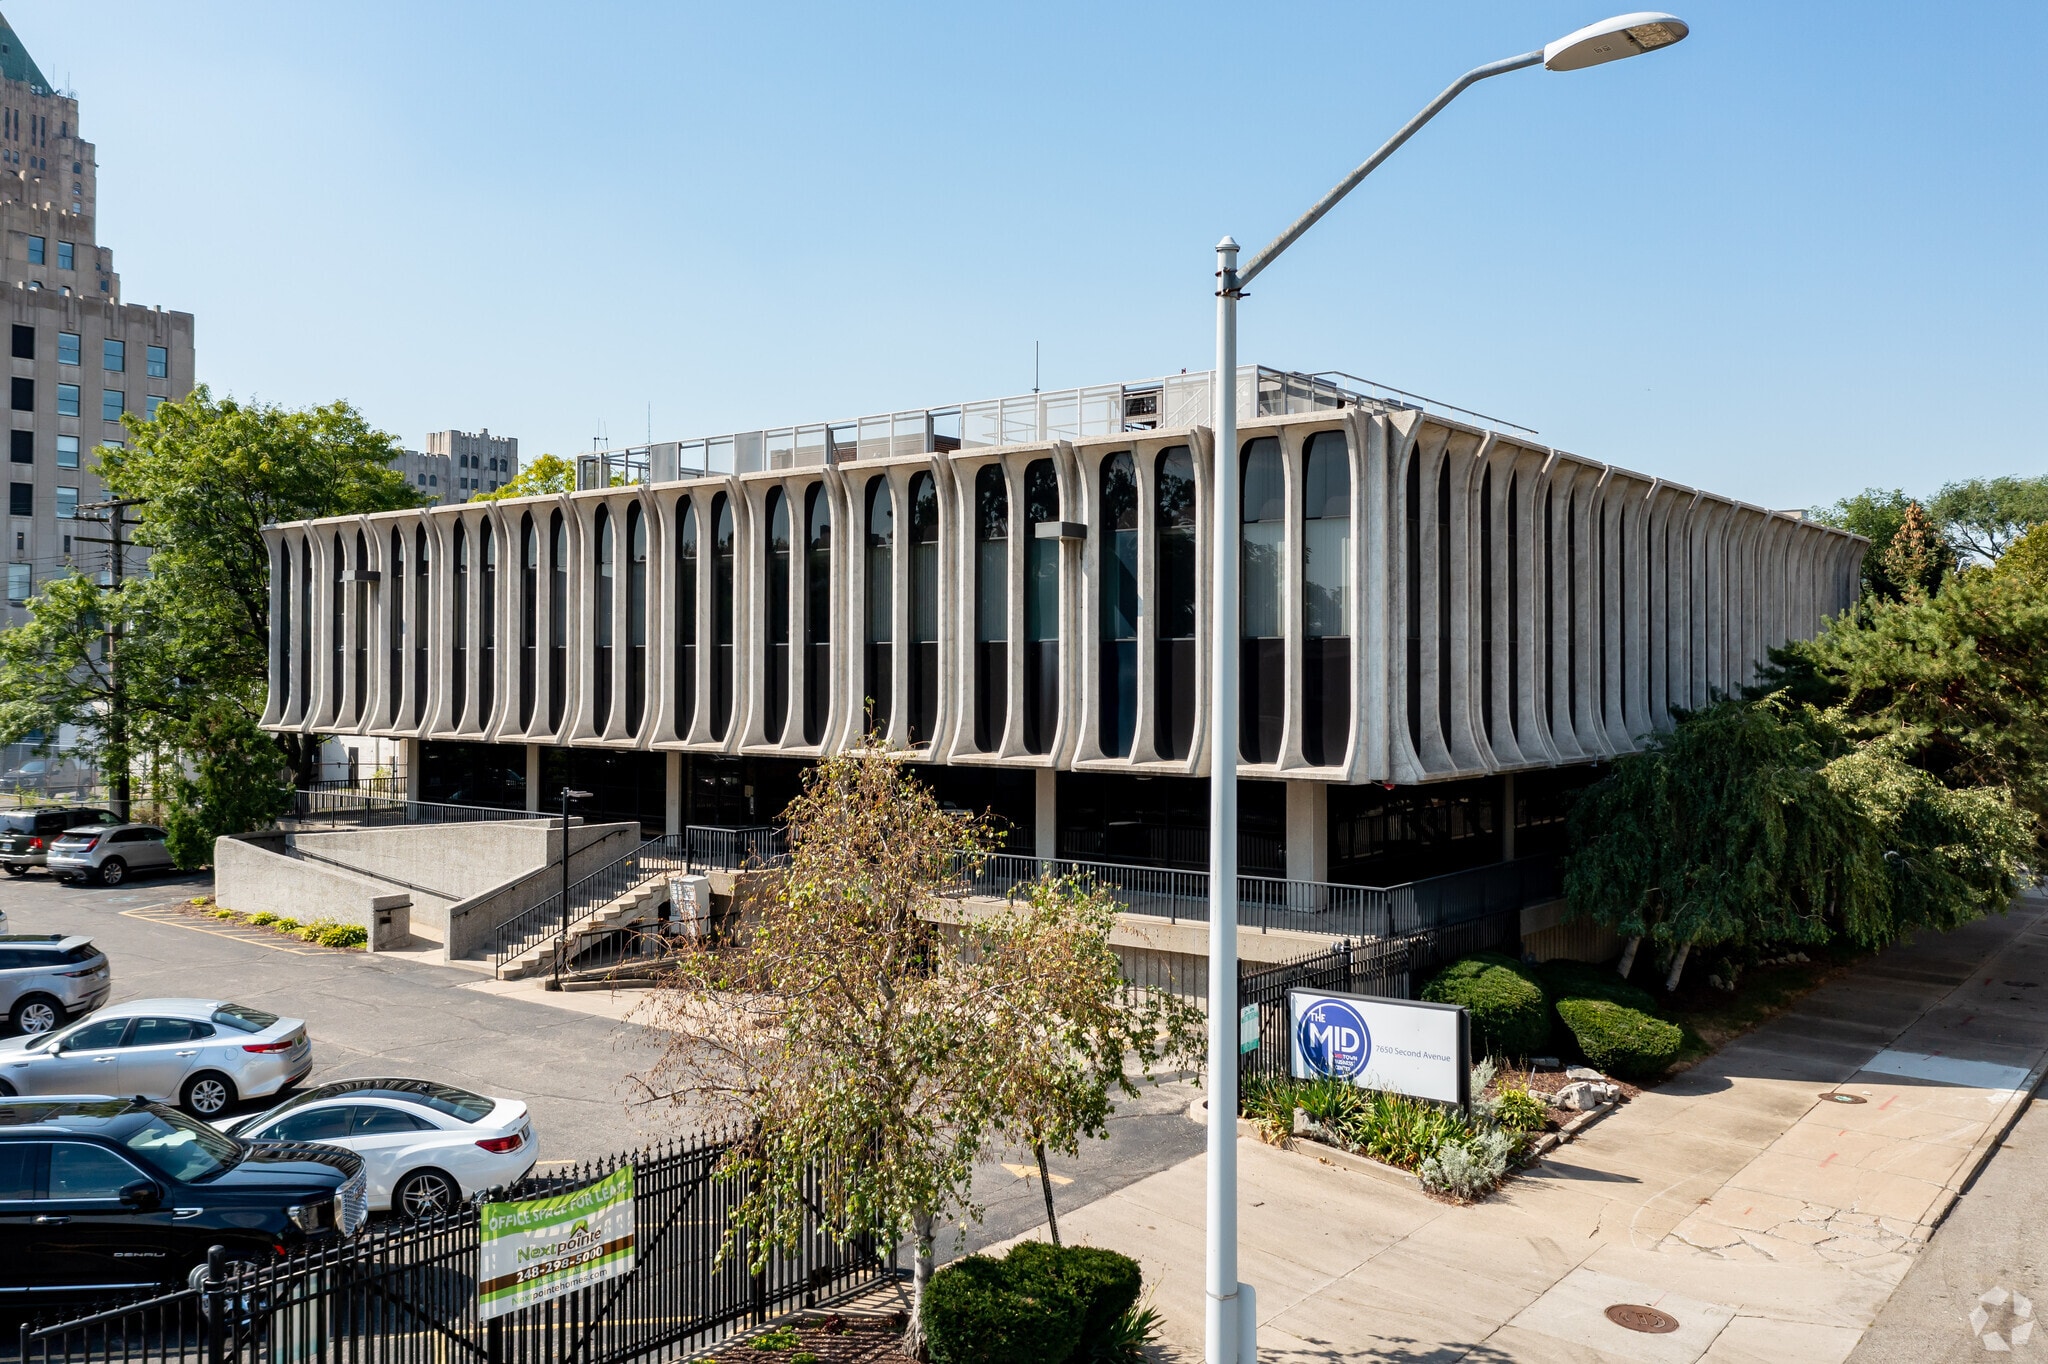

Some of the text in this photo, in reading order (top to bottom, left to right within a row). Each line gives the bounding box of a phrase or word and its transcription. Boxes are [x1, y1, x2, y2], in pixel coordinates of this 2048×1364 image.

[1310, 1008, 1326, 1023] THE
[1310, 1022, 1360, 1068] MID
[1376, 1045, 1451, 1062] 7650 Second Avenue
[489, 1181, 627, 1231] OFFICE SPACE FOR LEASE
[516, 1245, 604, 1283] 248-298-5000
[517, 1228, 602, 1264] Nextpointe
